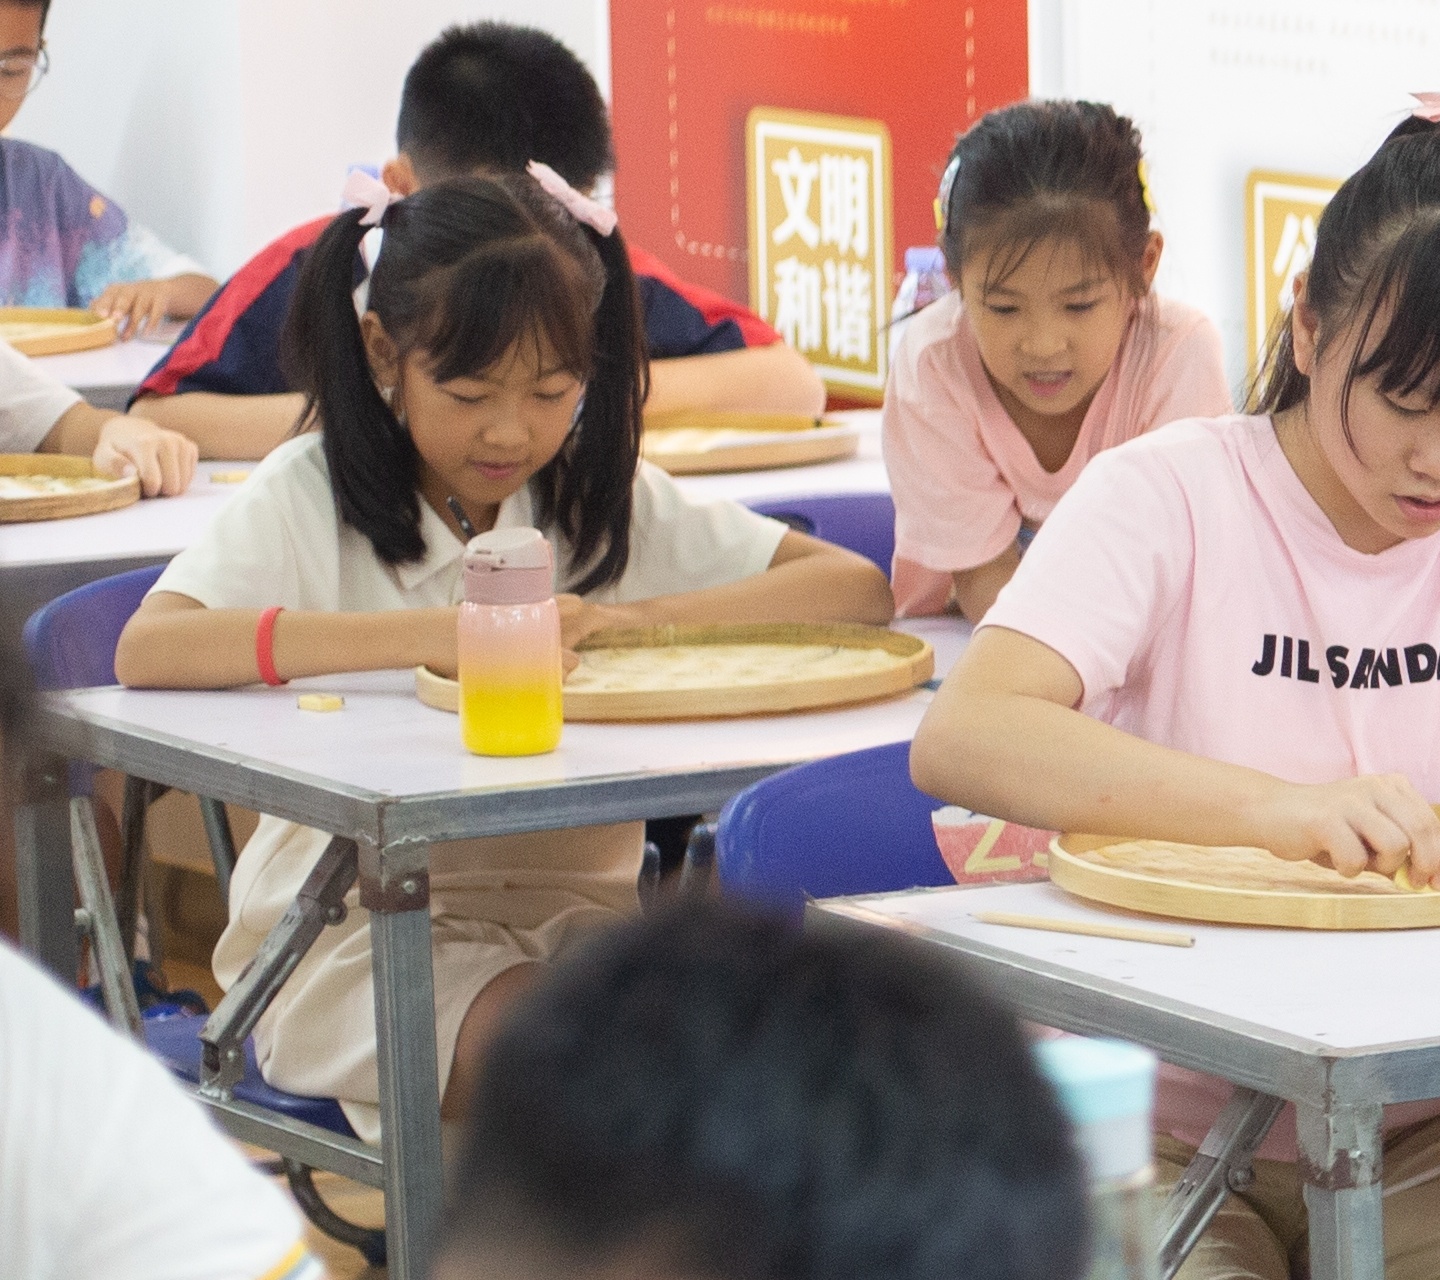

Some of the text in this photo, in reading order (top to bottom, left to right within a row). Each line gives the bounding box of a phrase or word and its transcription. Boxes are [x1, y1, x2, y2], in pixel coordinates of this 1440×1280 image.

[772, 147, 870, 253] 文明
[773, 259, 870, 364] 和谐
[1251, 633, 1319, 683] JIL
